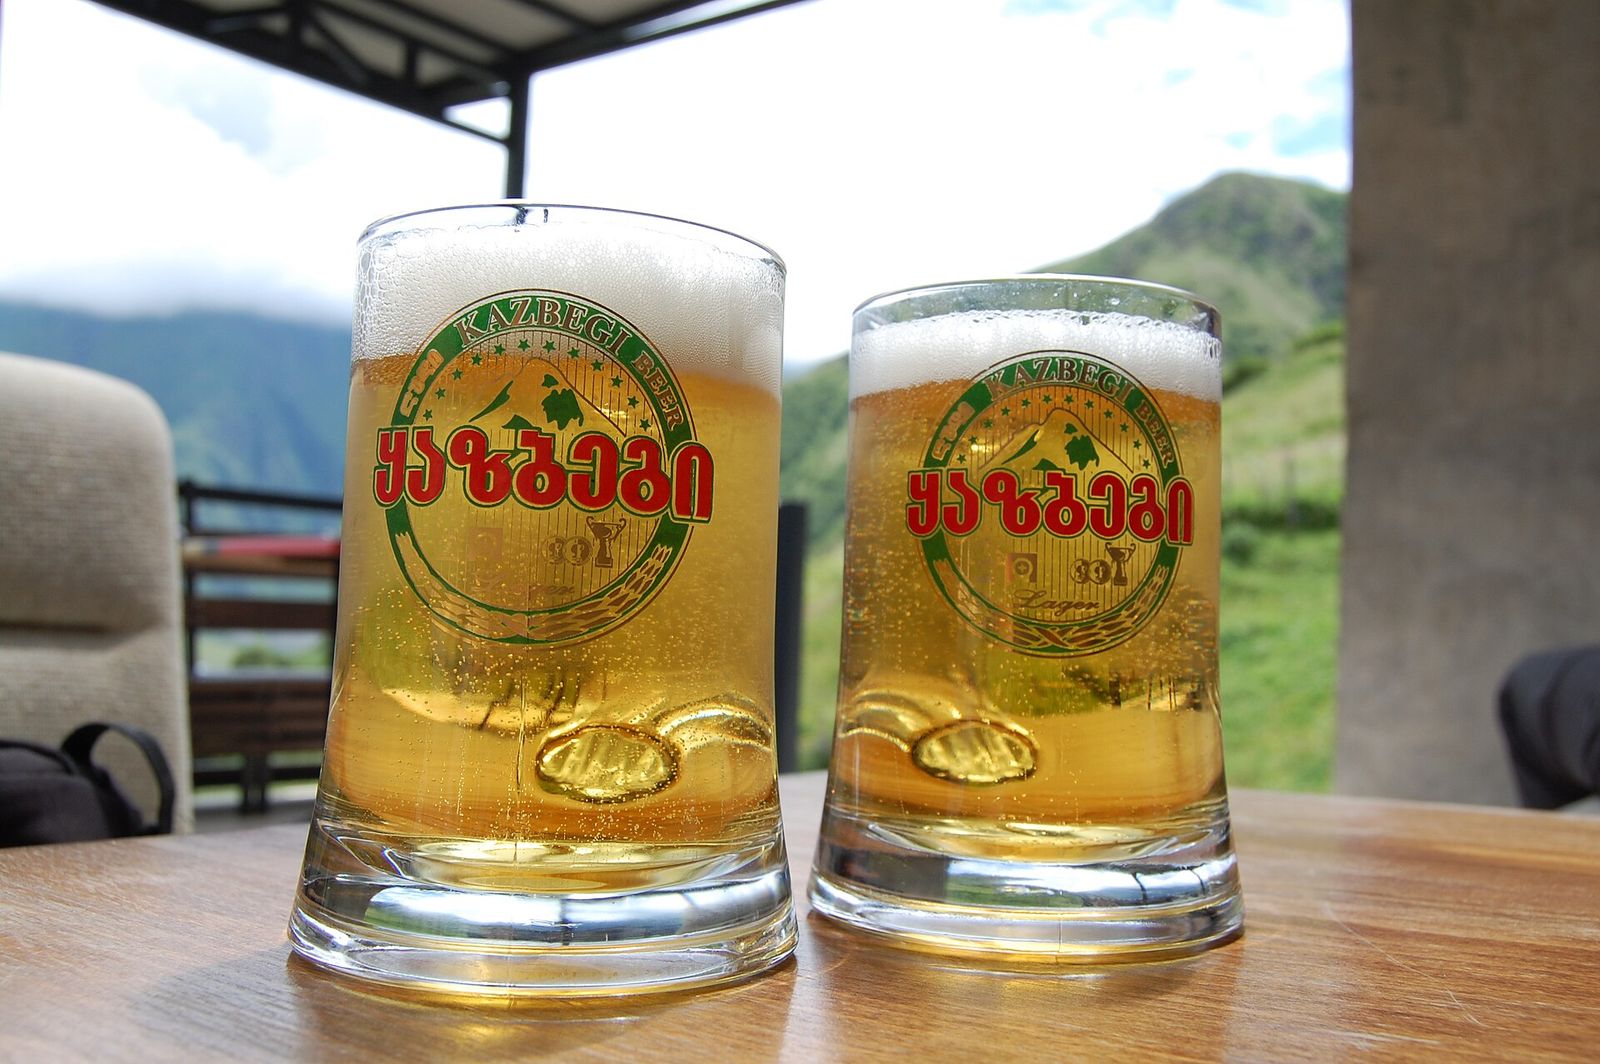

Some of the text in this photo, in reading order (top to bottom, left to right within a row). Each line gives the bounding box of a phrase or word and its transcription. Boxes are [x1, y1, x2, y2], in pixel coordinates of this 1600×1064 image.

[453, 297, 684, 431] KAZBEGI BEER
[982, 357, 1175, 469] KAZBEGI BEER
[373, 426, 714, 524] ყაზბეგი
[906, 468, 1194, 546] ყაზბეგი
[1013, 588, 1100, 617] Lager
